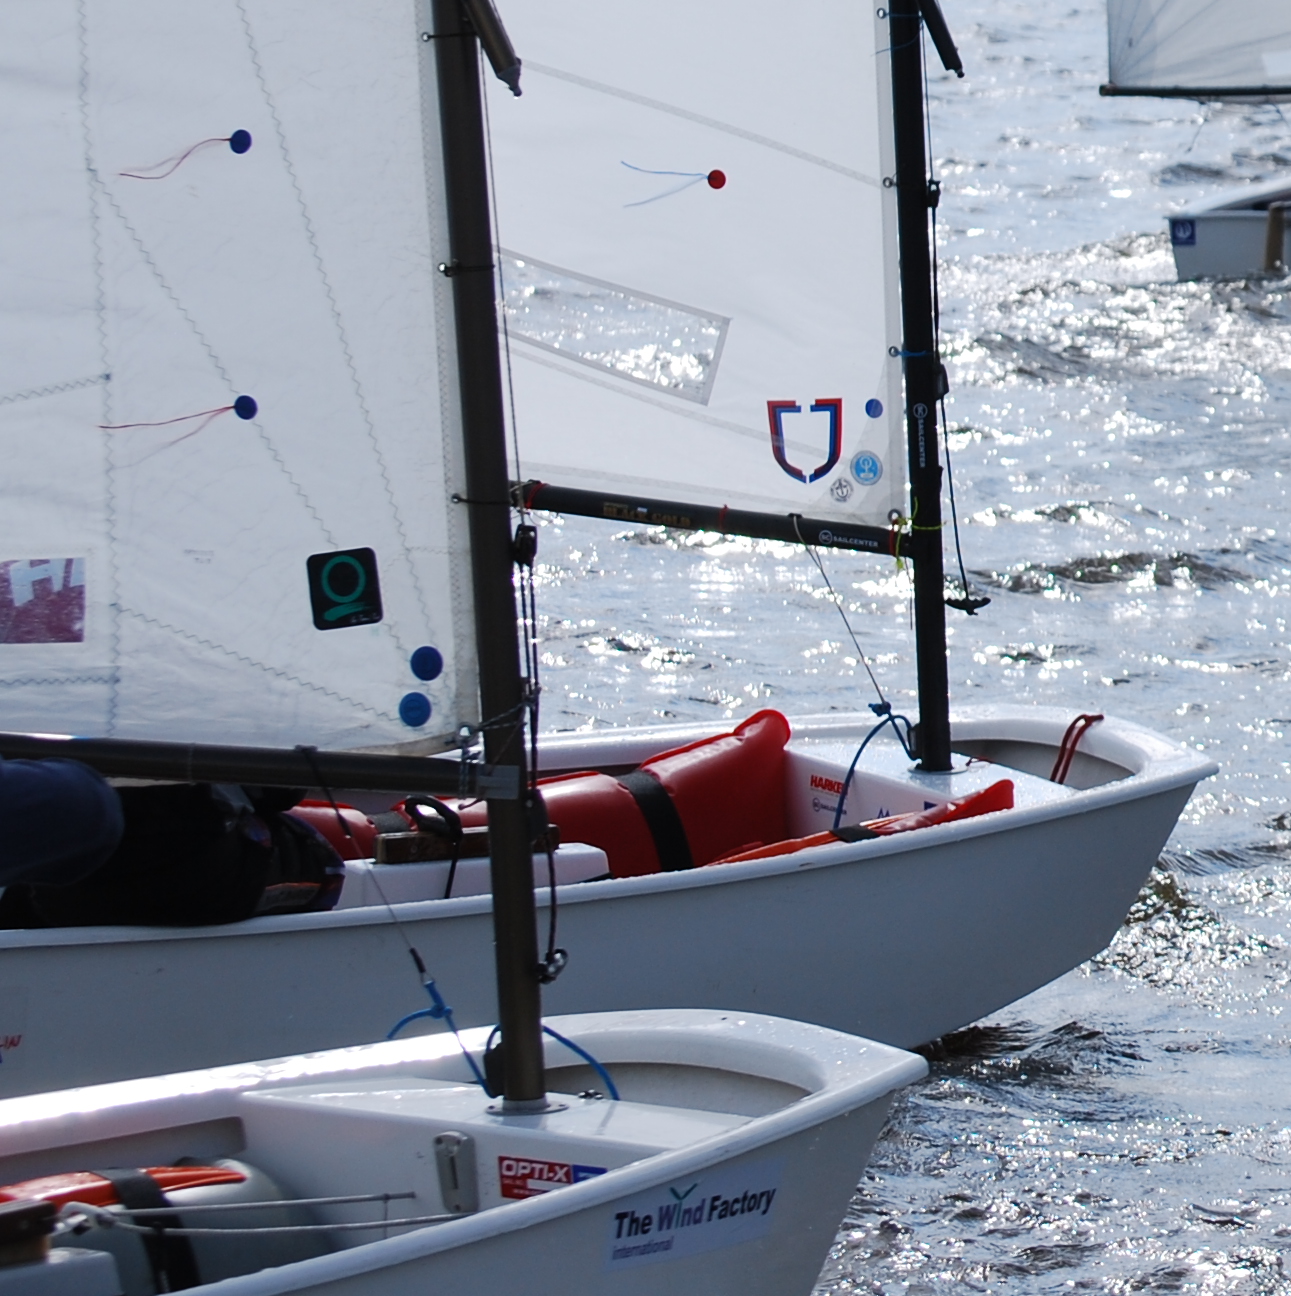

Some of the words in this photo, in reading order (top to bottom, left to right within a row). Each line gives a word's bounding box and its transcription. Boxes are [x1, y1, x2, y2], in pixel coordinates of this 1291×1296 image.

[918, 418, 926, 468] SAILCENTER
[833, 535, 879, 547] SAILCENTER
[810, 774, 844, 795] HARKE
[501, 1159, 570, 1183] OPTI-X
[614, 1210, 653, 1239] The
[656, 1189, 706, 1232] Wind
[706, 1187, 777, 1223] Factory
